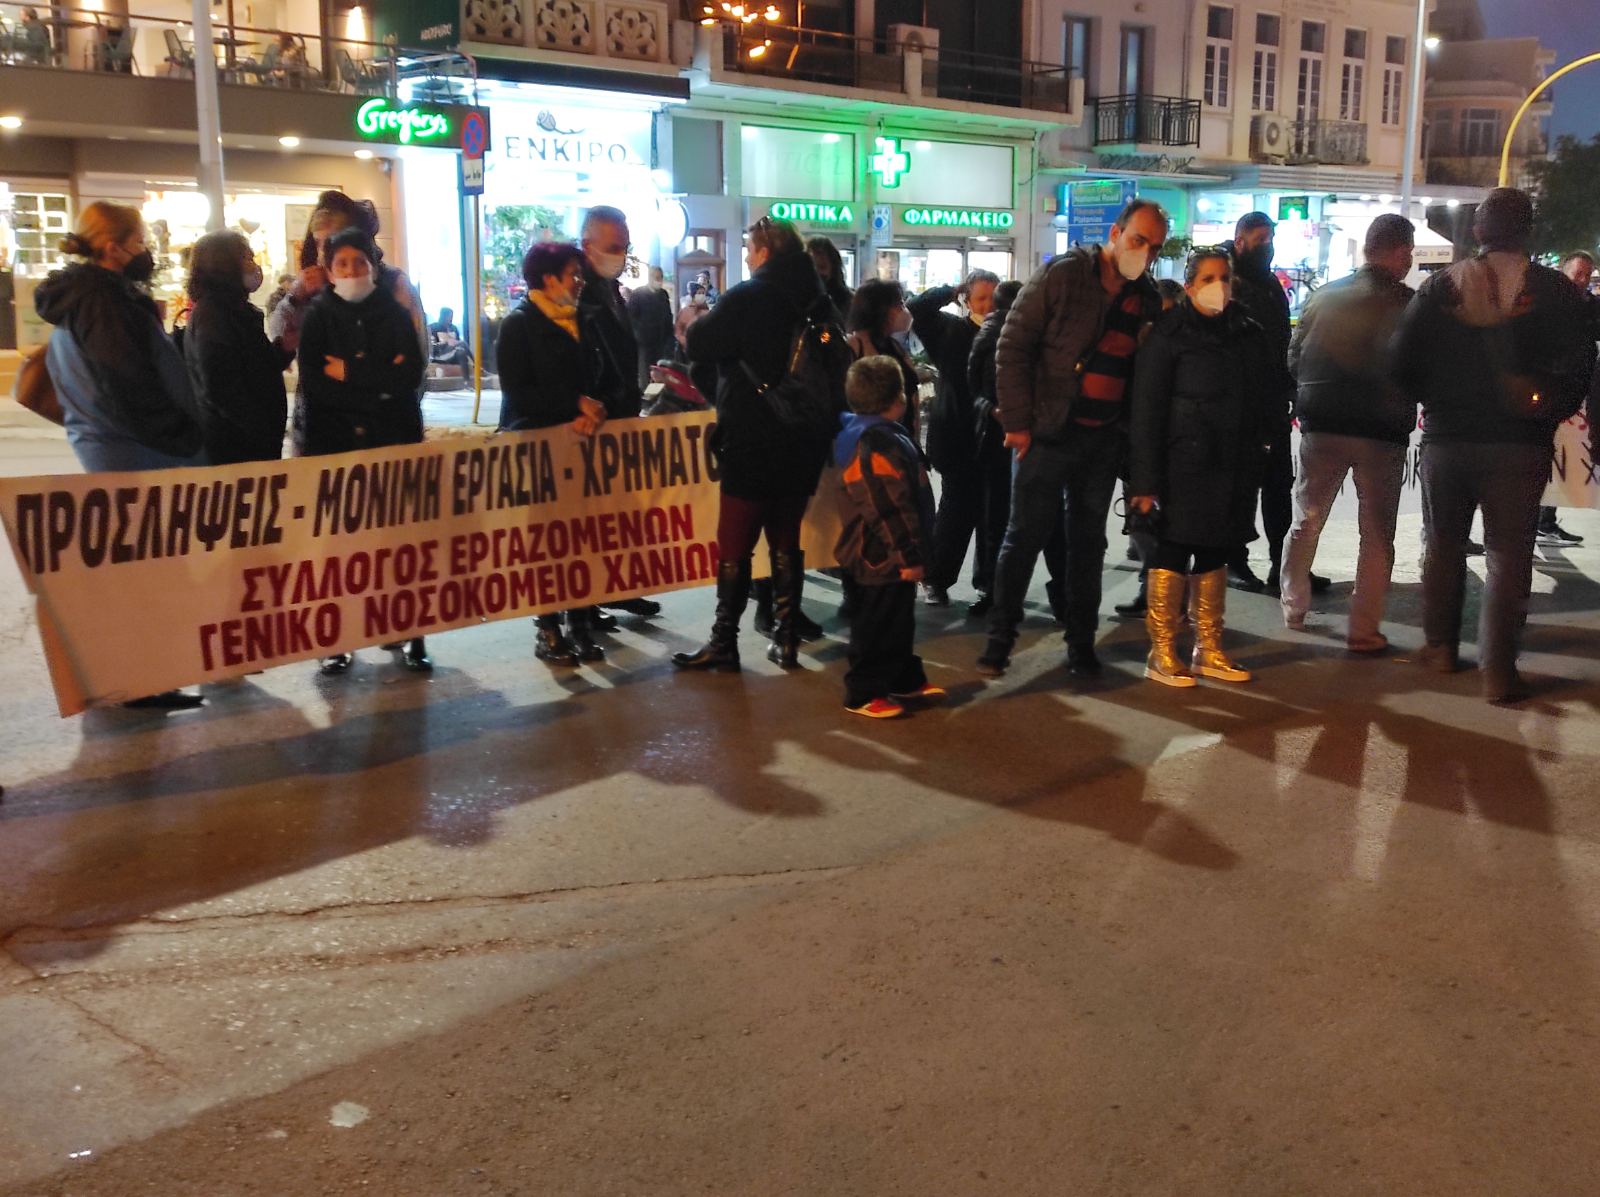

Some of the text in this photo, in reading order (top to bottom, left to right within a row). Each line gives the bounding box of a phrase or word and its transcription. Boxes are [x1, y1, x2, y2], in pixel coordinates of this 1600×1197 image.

[505, 136, 627, 163] ENKIPO
[771, 202, 854, 222] ΟΠΤΙΚΑ
[904, 208, 1014, 228] ΦΑΡΜΑΚΕΙΟ
[16, 473, 287, 574] ΠΡΟΣΛΗΨΕΙΣ
[313, 454, 444, 537] ΜΟΝΙΜΗ
[453, 439, 557, 516] ΕΡΓΑΣΙΑ
[241, 503, 694, 612] ΣΥΛΛΟΓΟΣ ΕΡΓΑΖΟΜΕΝΩΝ
[200, 602, 341, 671] ΓΕΝΙΚΟ
[364, 559, 591, 638] ΝΟΣΟΚΟΜΕΙΟ
